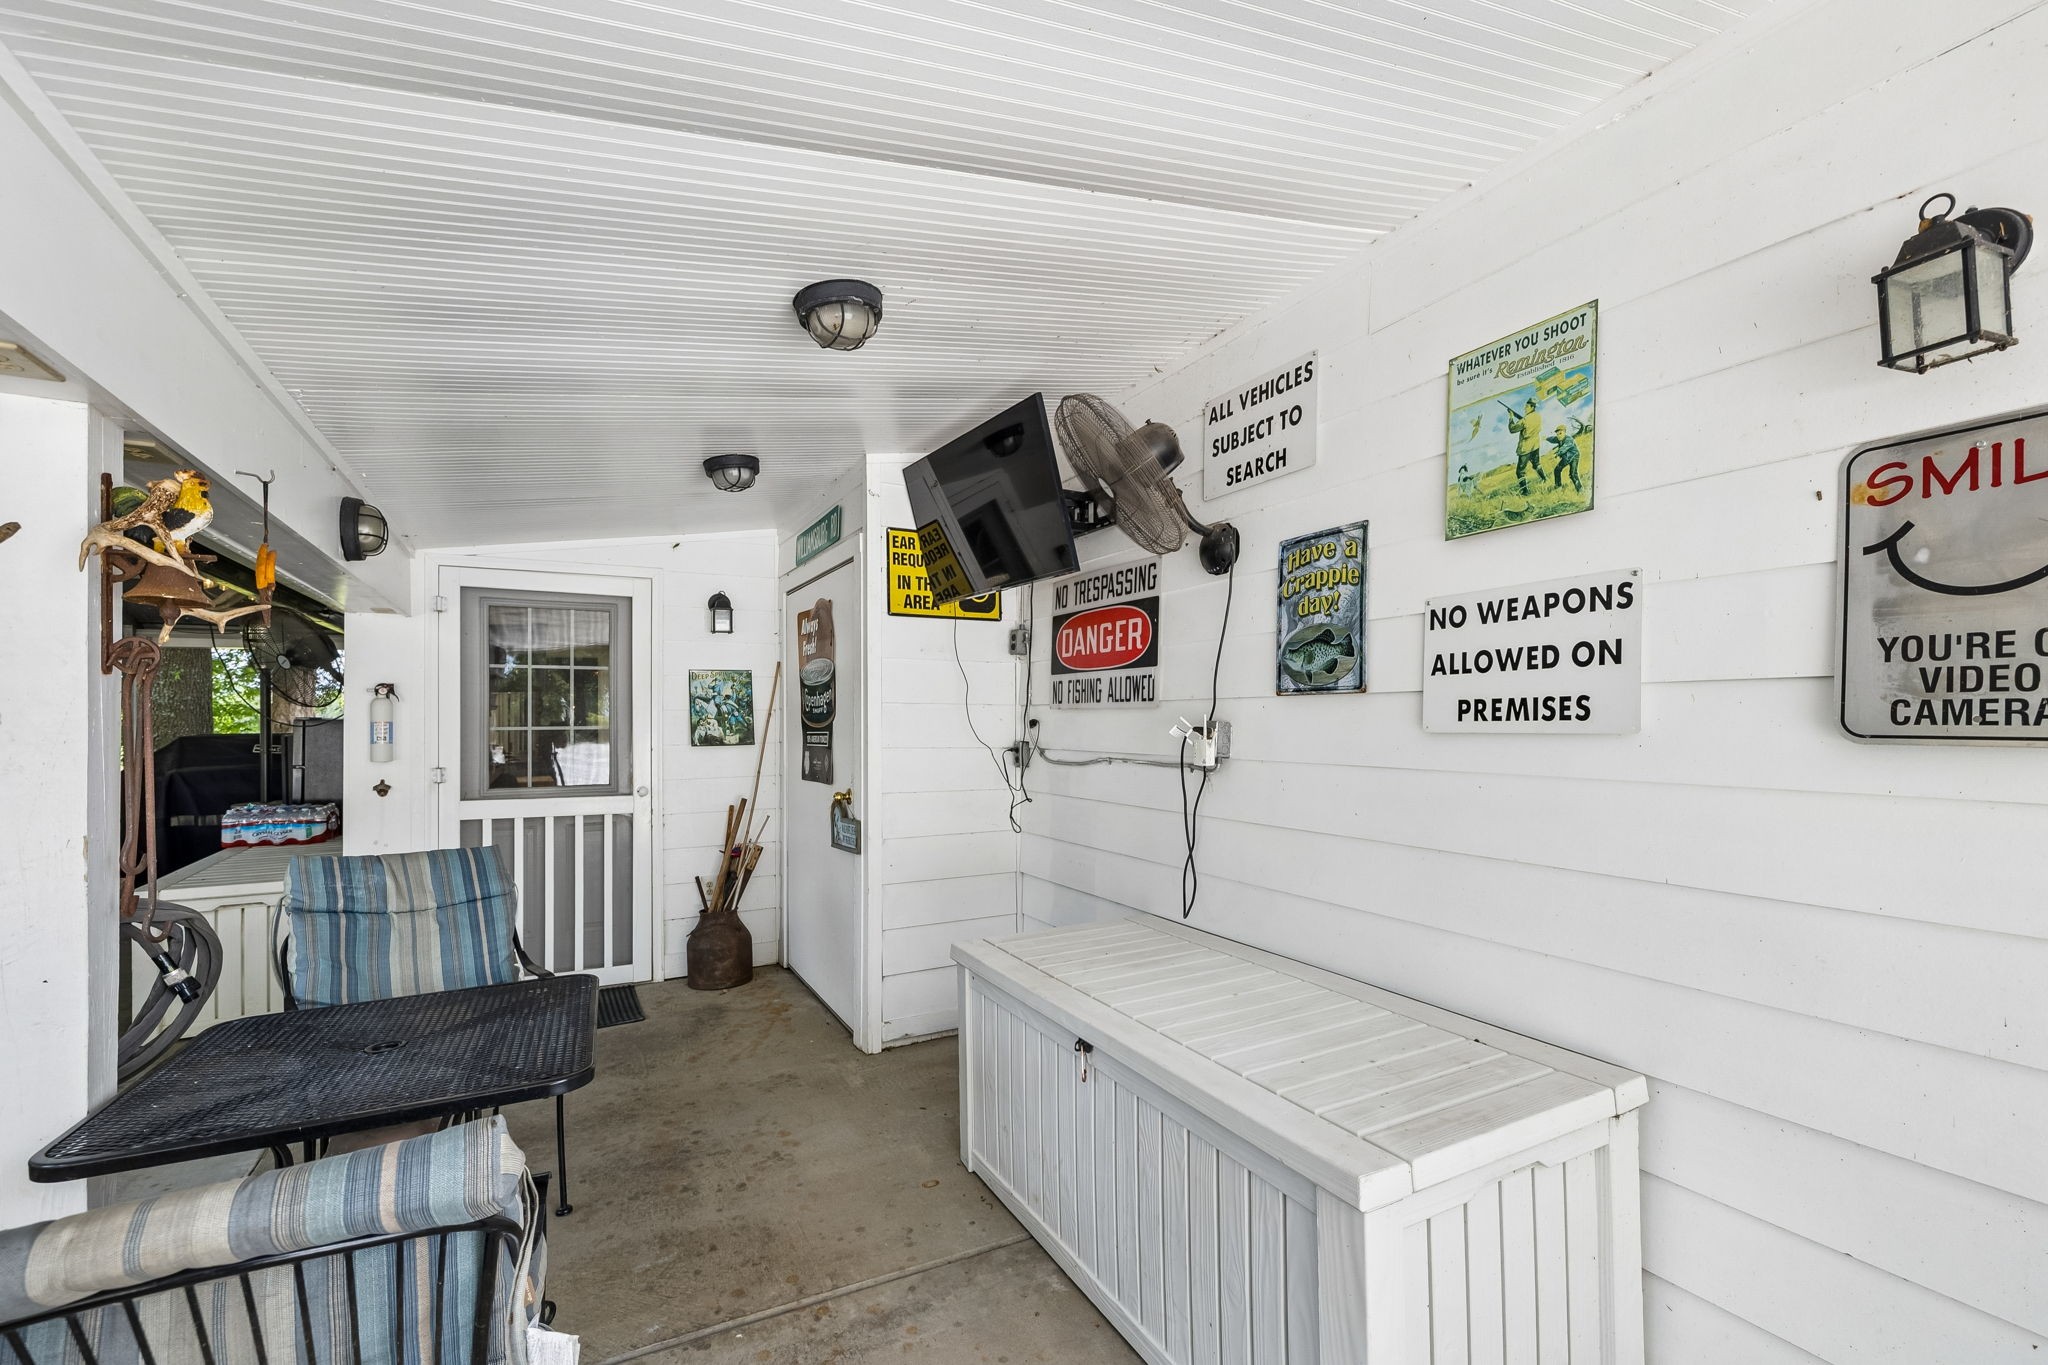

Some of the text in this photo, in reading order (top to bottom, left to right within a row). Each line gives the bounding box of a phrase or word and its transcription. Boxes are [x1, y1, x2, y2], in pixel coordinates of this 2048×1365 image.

[1456, 312, 1587, 375] WHATEVER YOU SHOOT
[1456, 378, 1465, 386] be
[1466, 373, 1480, 383] sure
[1482, 367, 1493, 377] it's
[1517, 361, 1555, 379] Established
[1208, 360, 1313, 426] ALL VEHICLES
[1212, 404, 1303, 458] SUBJECT TO
[1226, 447, 1287, 487] SEARCH
[830, 511, 838, 539] RD
[892, 535, 916, 550] EAR
[1286, 539, 1358, 573] Have a
[897, 575, 911, 590] IN
[1055, 562, 1158, 610] NO TRESPASSING
[1282, 563, 1360, 600] Crappie
[903, 594, 940, 610] AREA
[1297, 590, 1341, 617] day!
[1430, 581, 1634, 631] NO WEAPONS
[1061, 617, 1143, 658] DANGER
[1877, 630, 2017, 663] YOU'RE
[1431, 638, 1623, 676] ALLOWED ON
[691, 671, 709, 680] DEEP
[1052, 674, 1155, 705] NO FISHING ALLOWED
[1918, 662, 2041, 693] VIDEO
[1457, 694, 1591, 722] PREMISES
